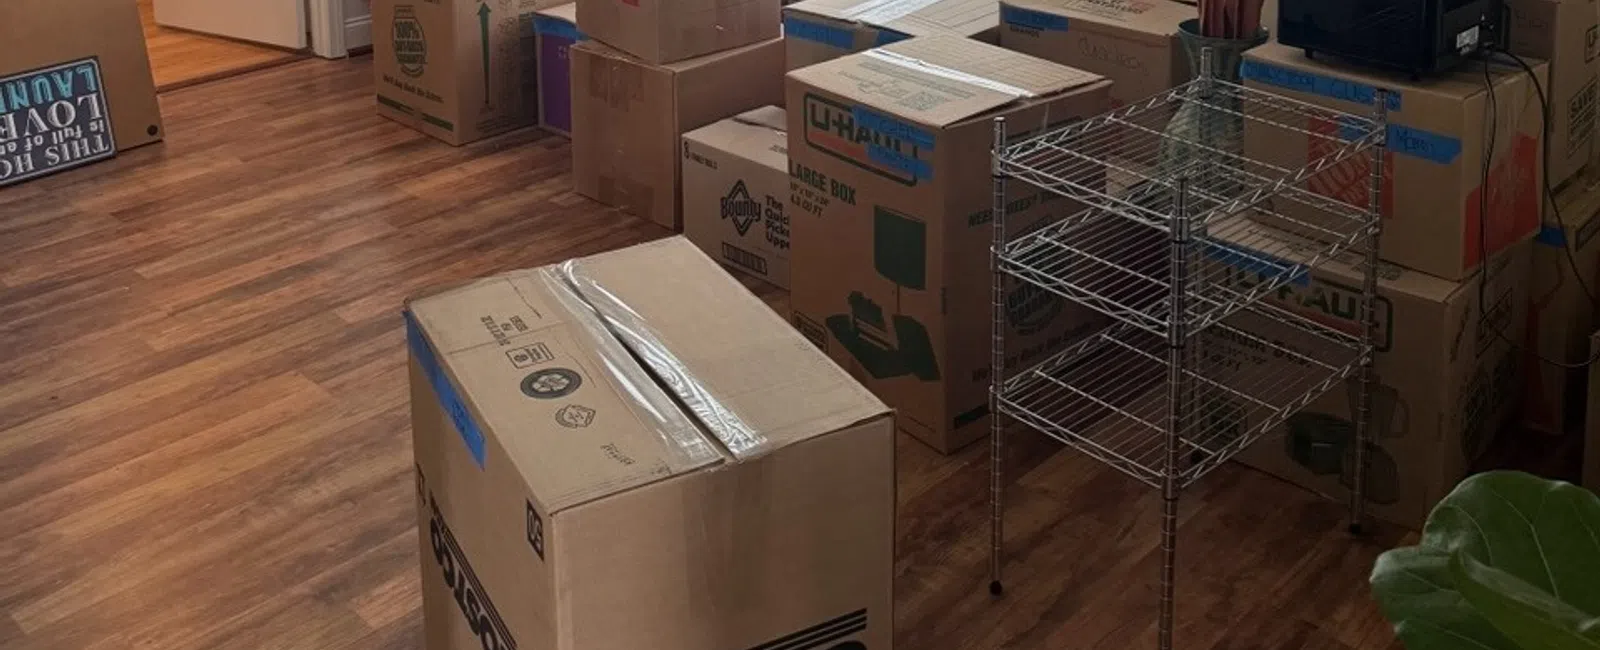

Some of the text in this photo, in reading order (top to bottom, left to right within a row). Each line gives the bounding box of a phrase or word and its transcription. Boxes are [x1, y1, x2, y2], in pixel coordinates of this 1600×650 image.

[51, 124, 84, 144] full
[90, 118, 105, 132] is
[24, 134, 44, 151] of
[46, 141, 110, 168] THIS
[788, 157, 857, 206] LARGE BOX
[720, 196, 761, 223] Bounty
[765, 194, 784, 212] The
[429, 517, 508, 650] OSTCO
